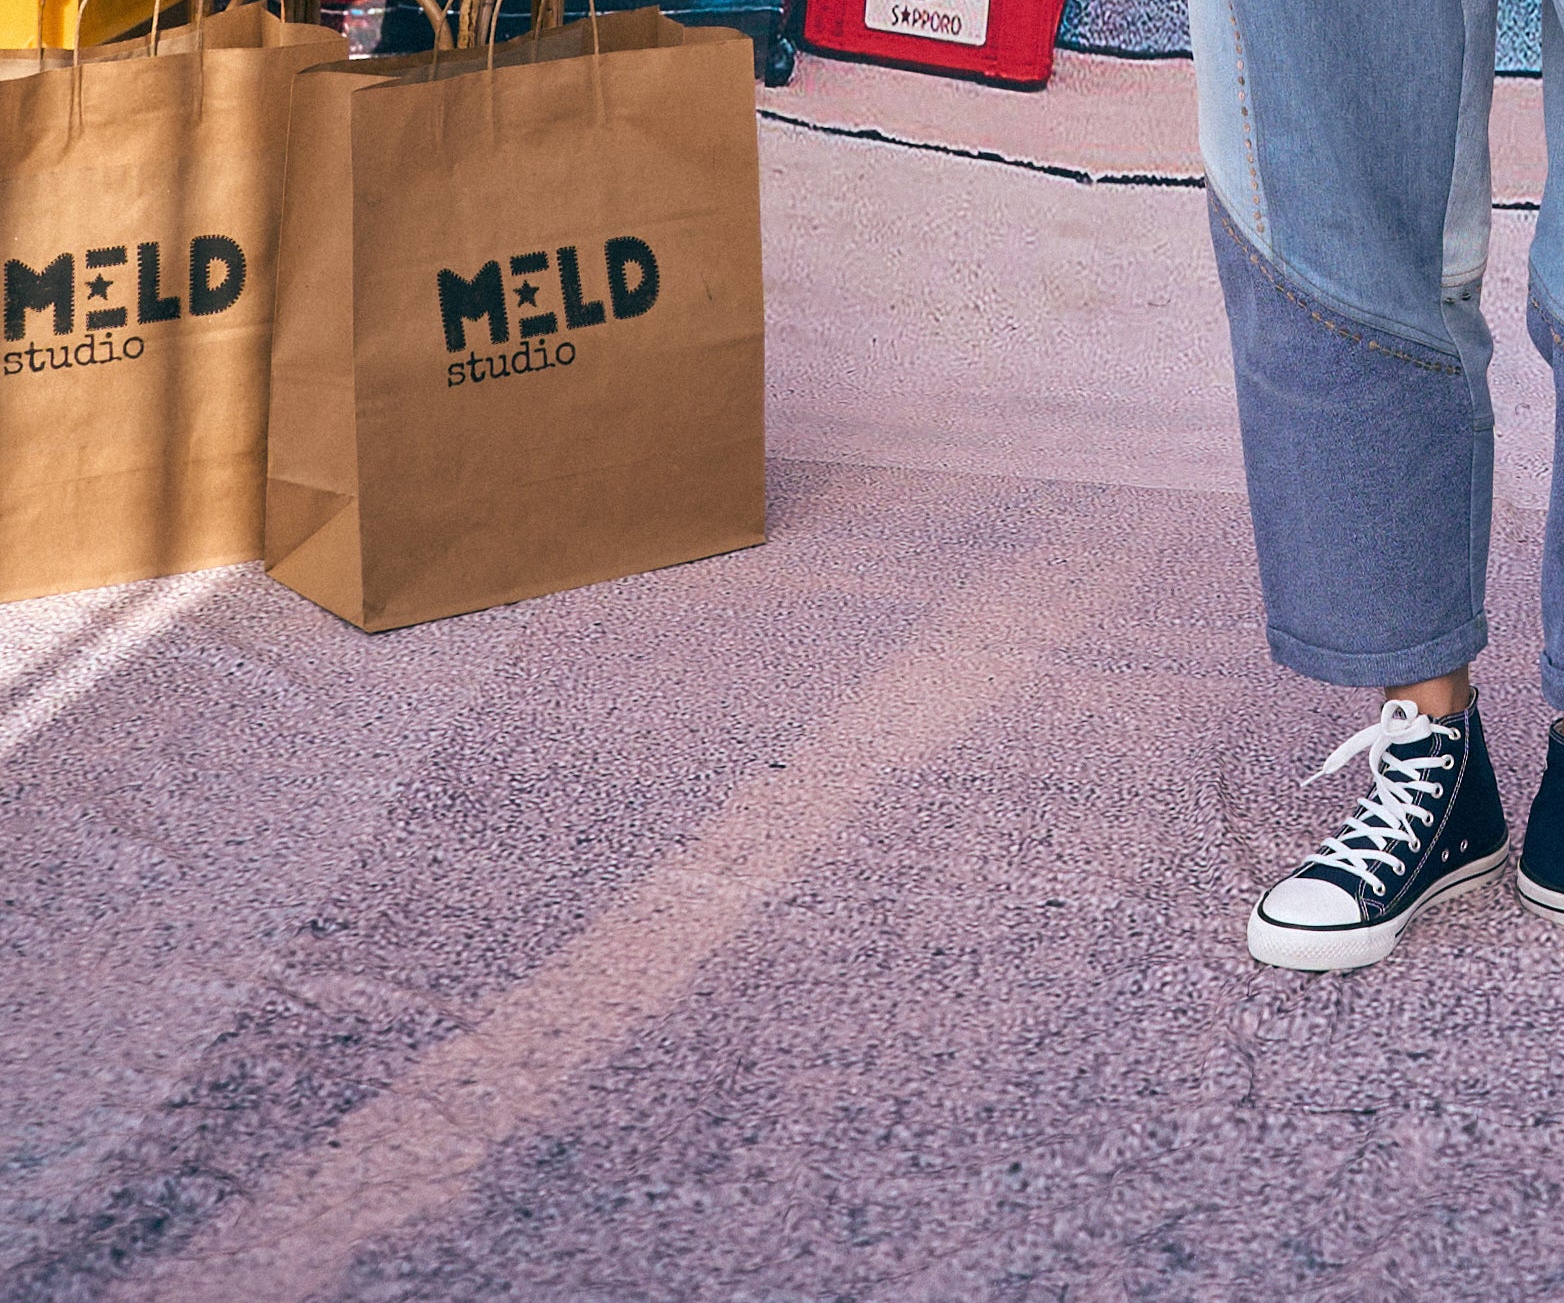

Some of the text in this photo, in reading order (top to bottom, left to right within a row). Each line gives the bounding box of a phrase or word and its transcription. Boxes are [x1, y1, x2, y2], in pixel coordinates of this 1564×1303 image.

[4, 234, 247, 342] MELD
[437, 236, 661, 354] MELD
[4, 332, 145, 375] studio
[448, 338, 576, 388] studio
